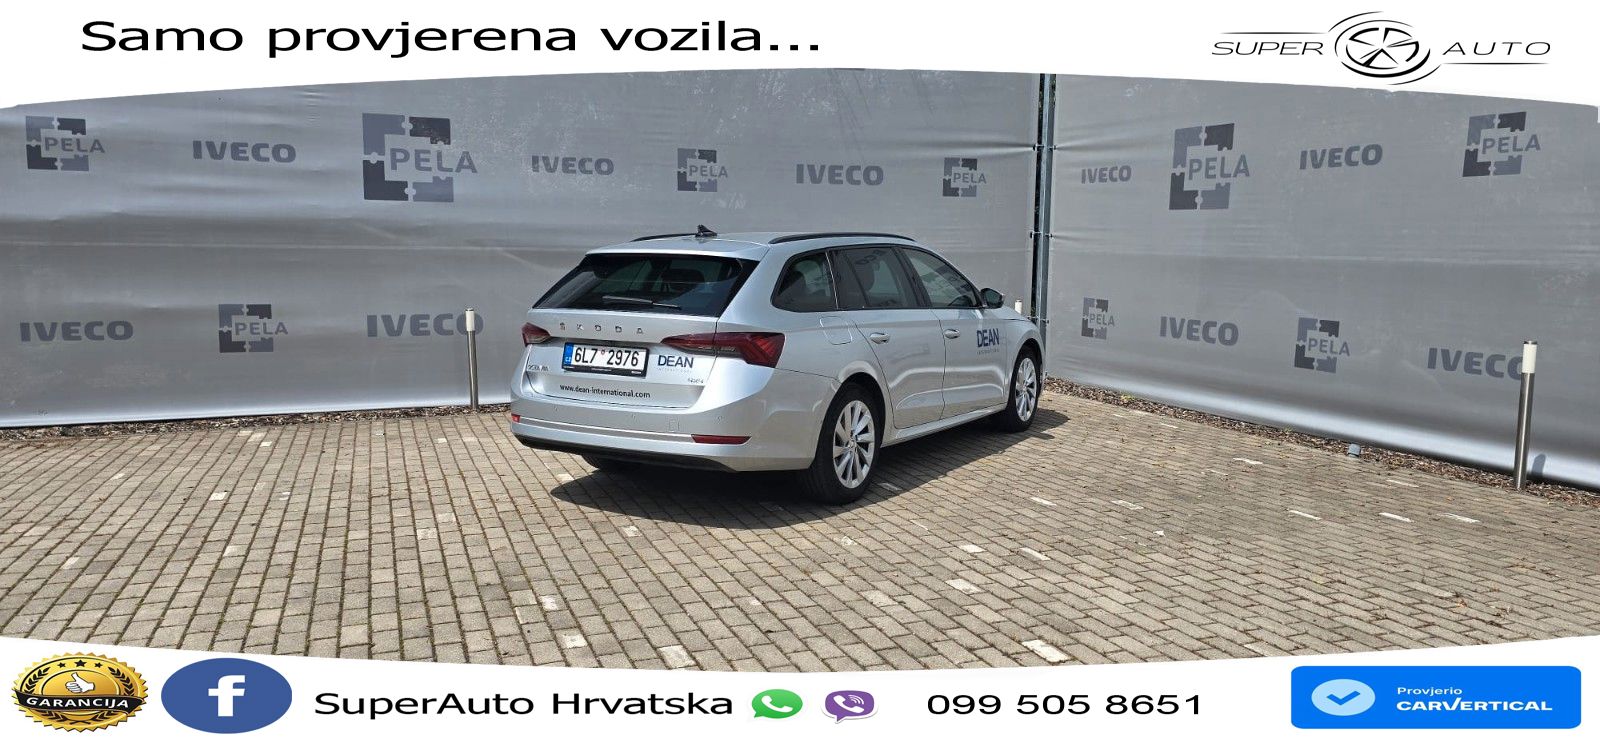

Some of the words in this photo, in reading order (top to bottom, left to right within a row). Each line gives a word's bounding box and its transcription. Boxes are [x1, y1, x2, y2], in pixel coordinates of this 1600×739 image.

[44, 136, 105, 154] PELA
[193, 140, 297, 163] IVECO
[1482, 135, 1541, 154] PELA
[389, 147, 478, 174] PELA
[531, 155, 615, 176] IVECO
[1300, 143, 1383, 170] IVECO
[689, 163, 729, 179] PELA
[796, 163, 884, 186] IVECO
[1081, 165, 1132, 184] IVECO
[1188, 154, 1250, 181] PELA
[953, 172, 987, 185] PELA
[235, 322, 289, 337] PELA
[367, 313, 484, 338] IVECO
[1090, 313, 1115, 328] PELA
[20, 320, 134, 342] IVECO
[976, 328, 1000, 348] DEAN
[1160, 316, 1239, 346] IVECO
[574, 347, 598, 364] 6L7
[607, 349, 640, 367] 2976
[1308, 338, 1351, 357] PELA
[657, 355, 694, 368] DEAN
[559, 384, 651, 399] www.dean-international.com
